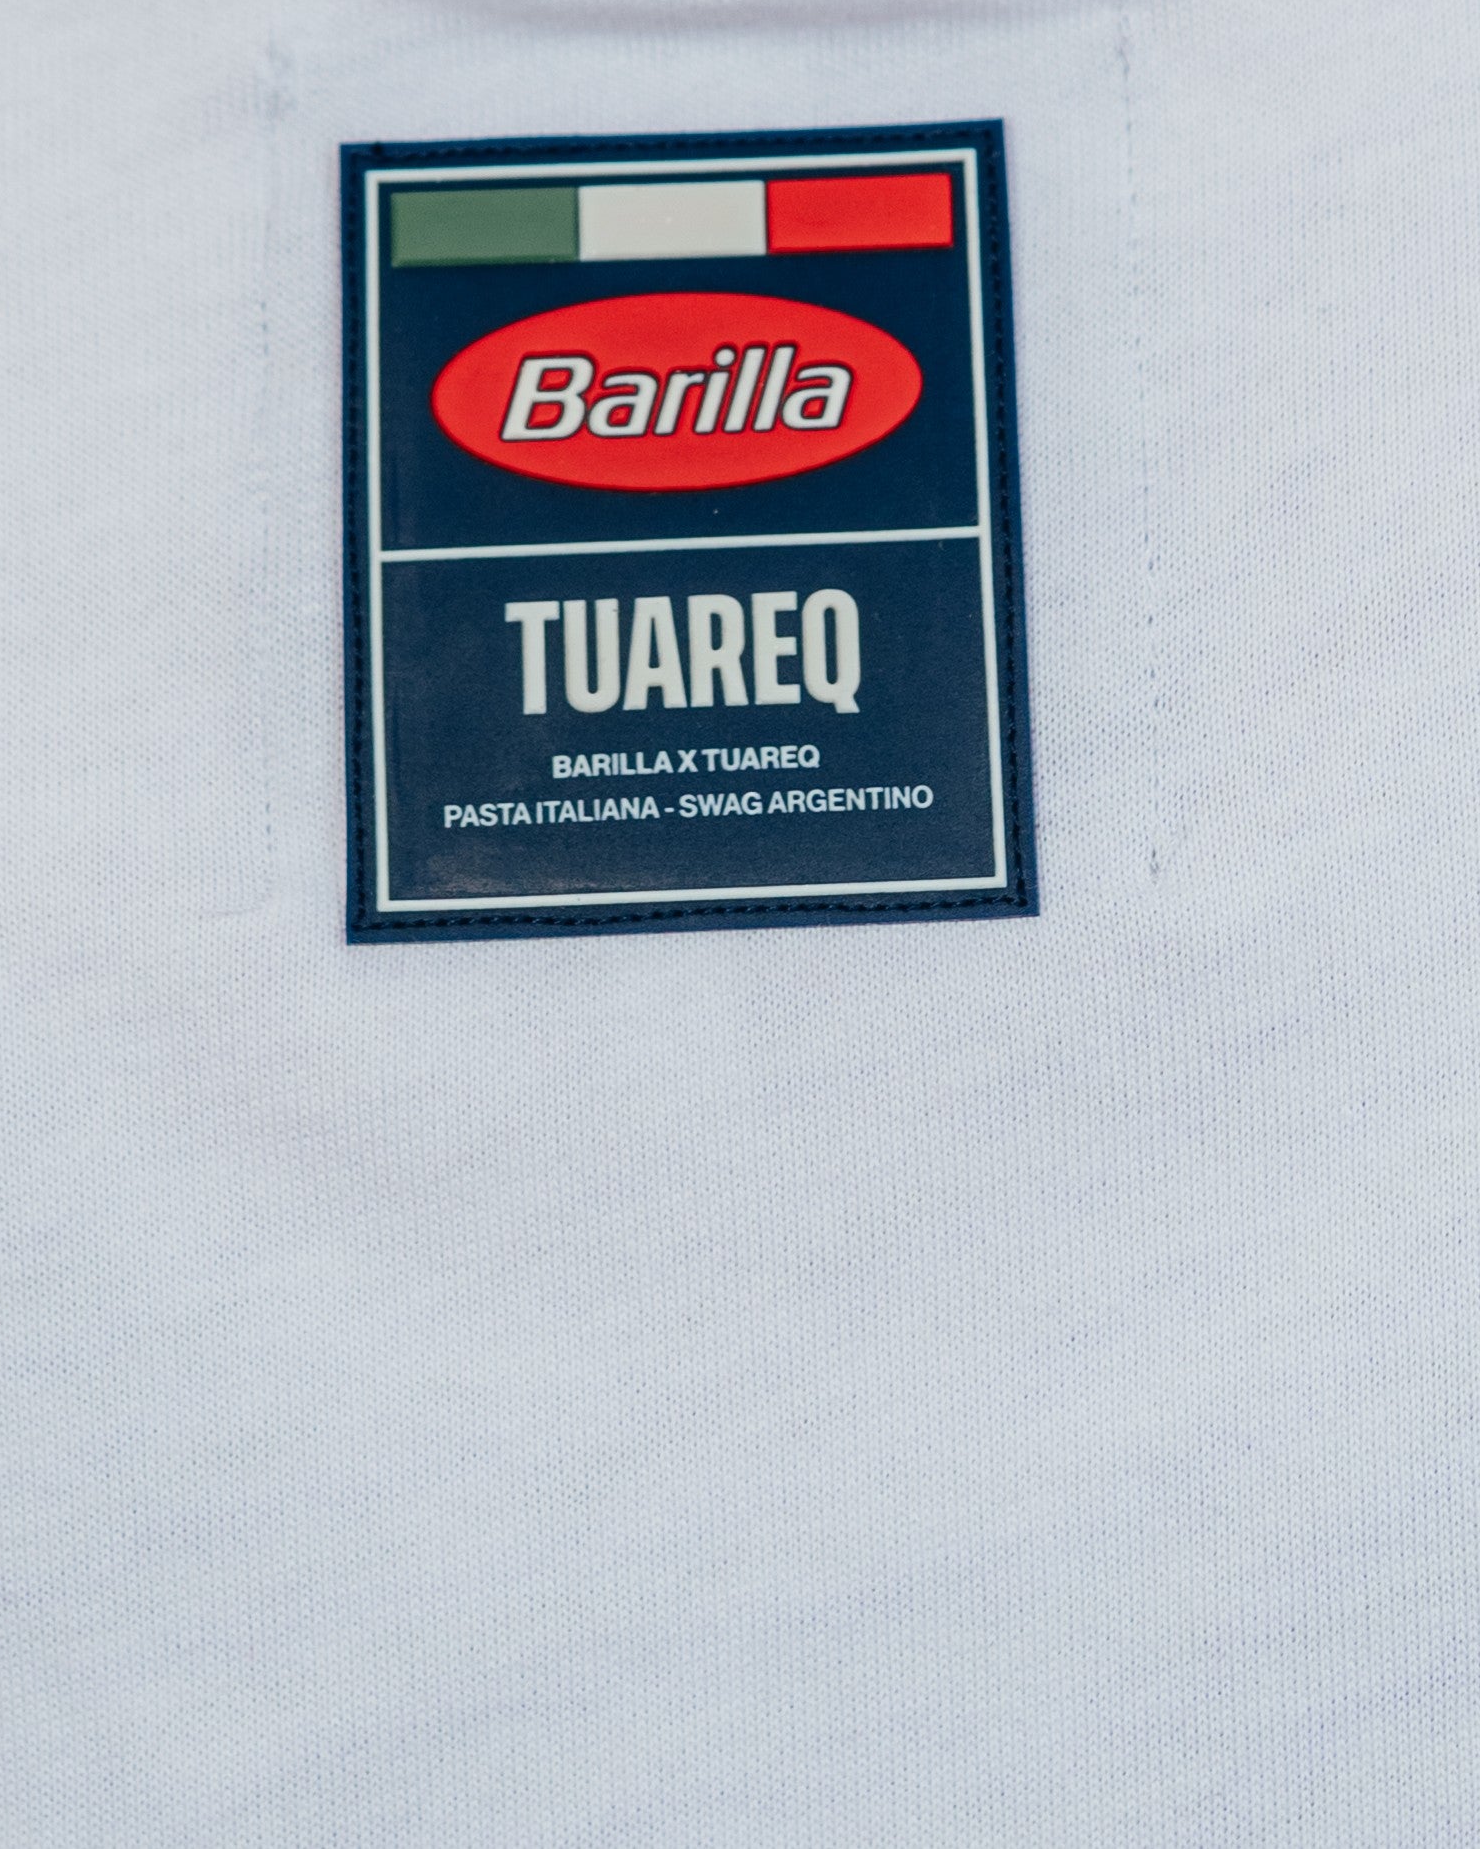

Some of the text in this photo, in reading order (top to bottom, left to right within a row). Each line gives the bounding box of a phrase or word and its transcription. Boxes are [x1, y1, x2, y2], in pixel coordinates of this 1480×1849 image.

[499, 346, 853, 442] Barilla
[504, 588, 862, 716] TUAREQ
[551, 744, 821, 779] BARILLA X TUAREQ
[443, 802, 532, 829] PASTA
[535, 796, 660, 825] ITALIANA
[678, 791, 763, 819] SWAG
[766, 784, 934, 815] ARGENTINO
